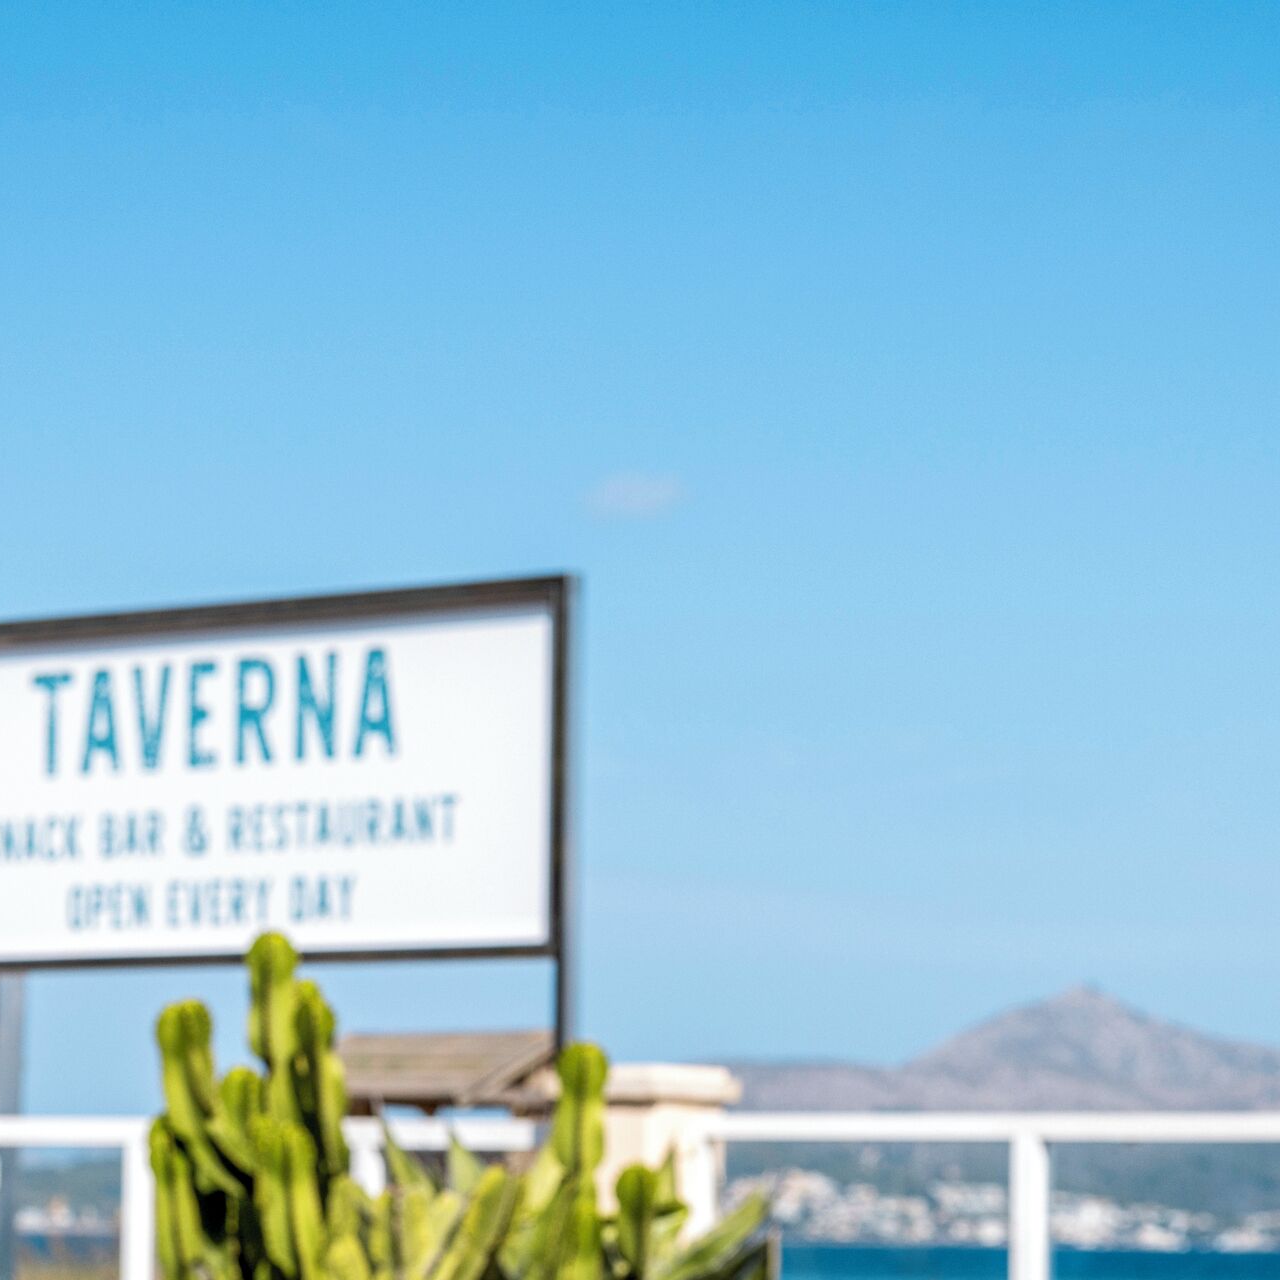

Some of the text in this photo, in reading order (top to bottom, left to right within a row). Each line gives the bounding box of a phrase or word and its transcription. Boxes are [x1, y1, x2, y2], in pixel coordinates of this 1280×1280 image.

[30, 643, 400, 779] TAVERNA
[98, 807, 165, 859] BAR
[183, 802, 210, 858] &
[225, 794, 458, 853] RESTAURANT
[67, 873, 356, 931] OPEN EVERY DAY
